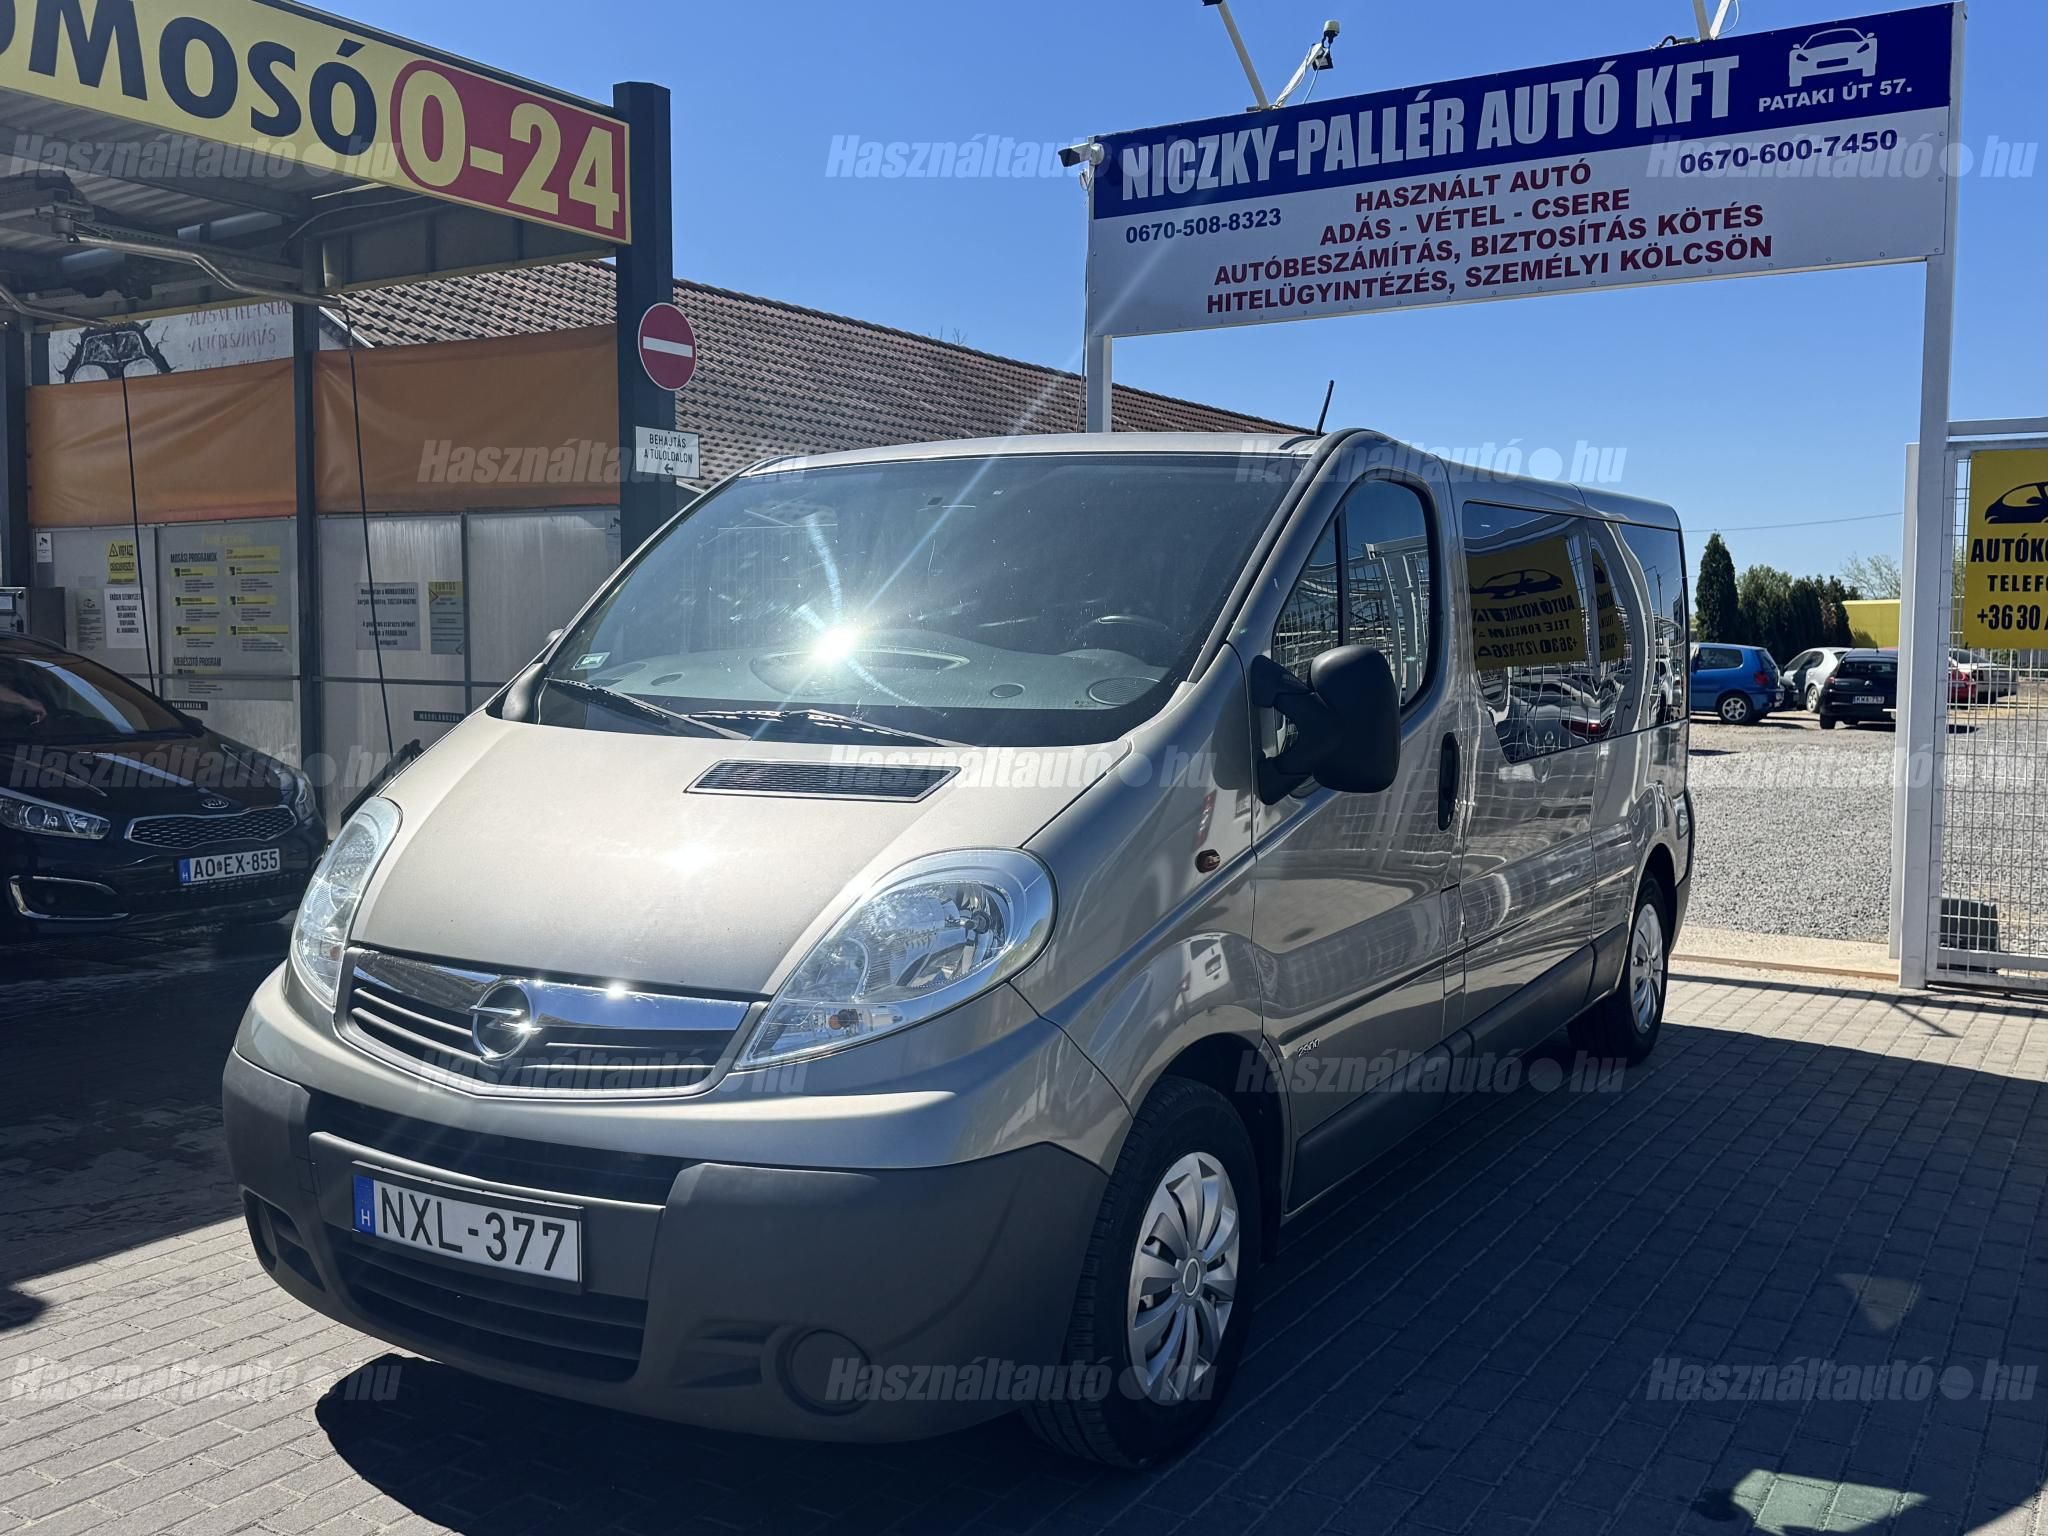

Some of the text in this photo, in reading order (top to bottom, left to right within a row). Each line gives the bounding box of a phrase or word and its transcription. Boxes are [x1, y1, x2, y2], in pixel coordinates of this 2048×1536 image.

[1758, 78, 1913, 112] PATAKI ÚT 57.
[400, 69, 619, 230] 0-24
[1123, 55, 1740, 200] NICZKY-PALLÉR AUTÓ KFT
[1680, 129, 1898, 174] 0670-600-7450
[1355, 158, 1592, 212] HASZNÁLT AUTÓ
[1125, 207, 1282, 244] 0670-508-8323
[1319, 219, 1391, 246] ADÁS
[1416, 205, 1505, 235] VÉTEL
[1531, 188, 1630, 220] CSERE
[1214, 202, 1763, 286] AUTÓBESZÁMÍTÁS, BIZTOSÍTÁS KÖTÉS
[1206, 235, 1772, 314] HITELÜGYINTÉZÉS, SZEMÉLYI KÖLCSÖN
[643, 447, 693, 464] A TÚLOLDALON
[649, 433, 687, 449] BEHAJTÁS
[1970, 533, 2048, 563] AUTÓK
[1987, 575, 2048, 592] TELEF
[361, 1187, 566, 1271] H NXL-377
